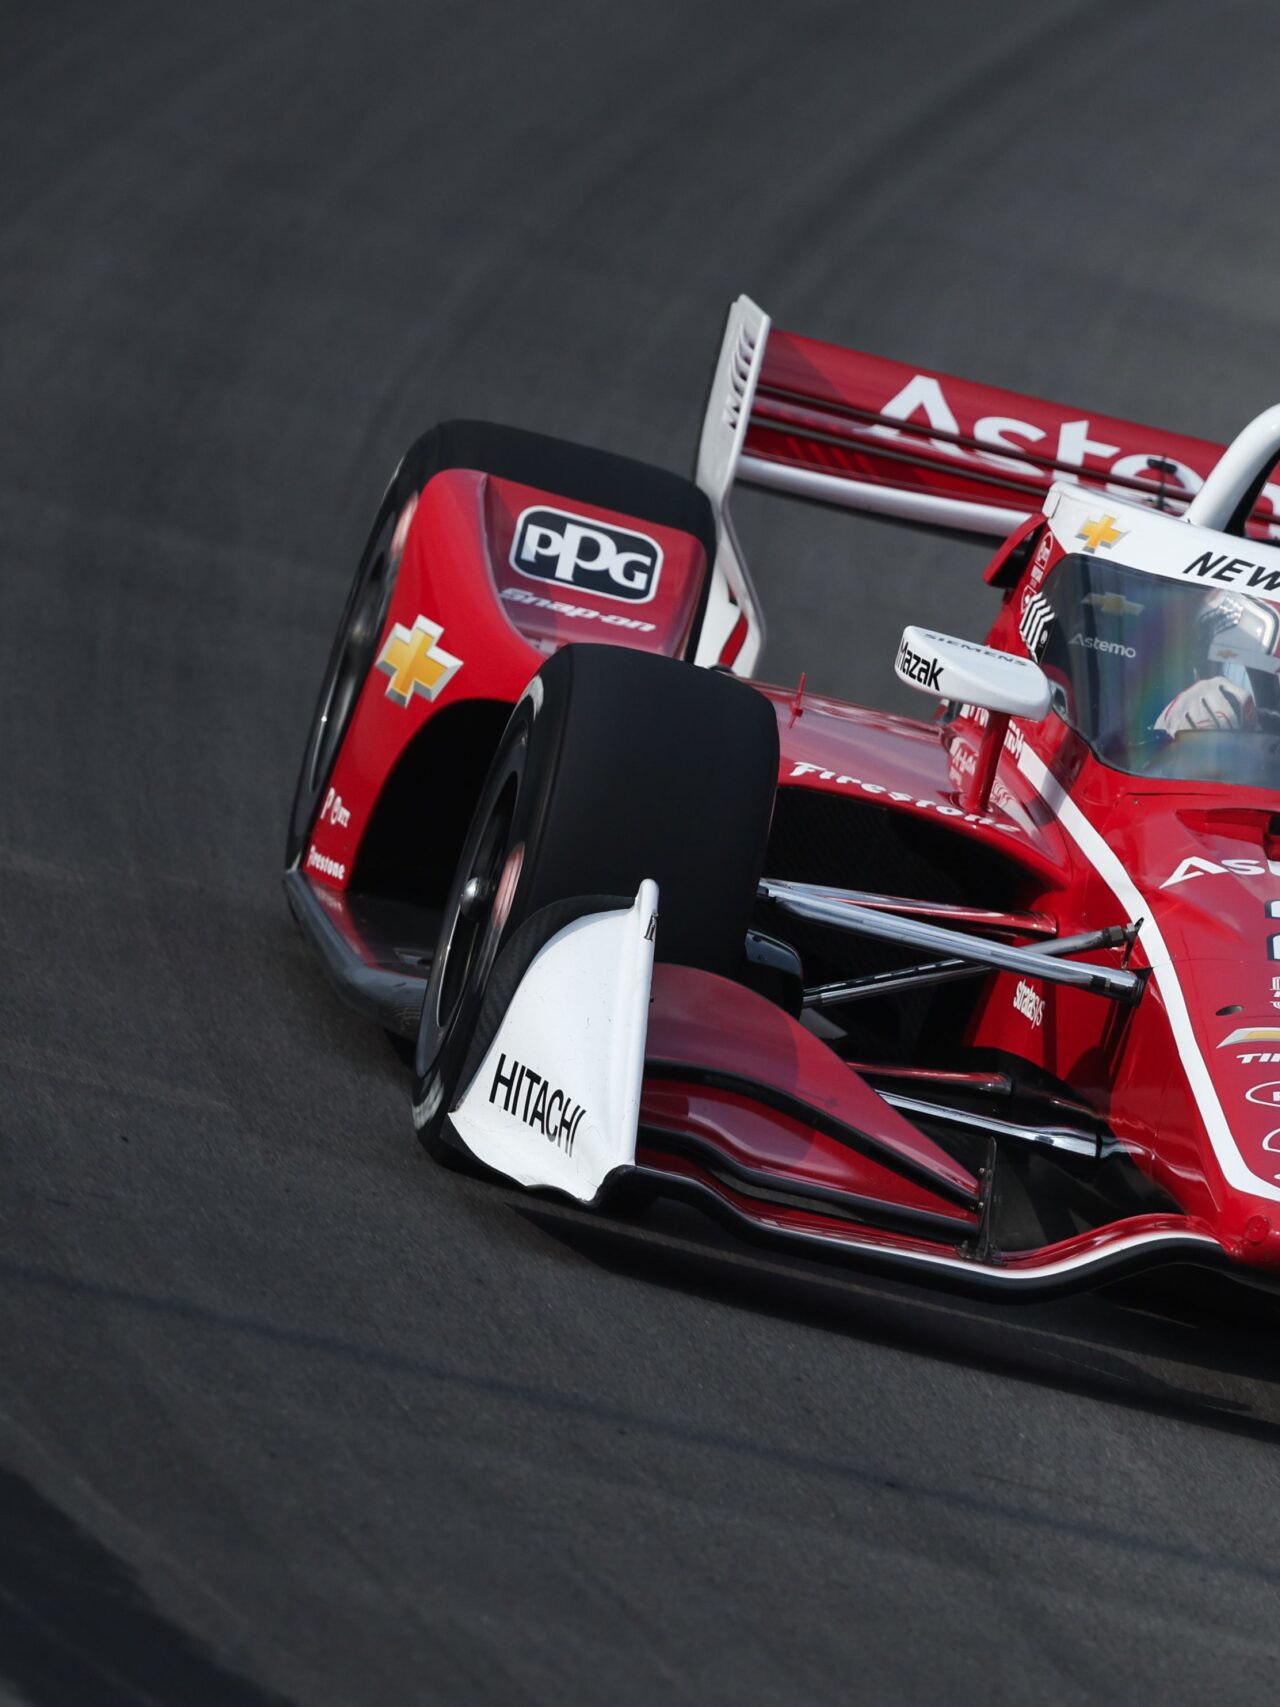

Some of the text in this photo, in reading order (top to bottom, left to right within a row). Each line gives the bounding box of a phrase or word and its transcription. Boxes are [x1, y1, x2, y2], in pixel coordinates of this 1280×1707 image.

[520, 522, 652, 591] PPG
[499, 587, 657, 632] Snap-on
[923, 633, 1028, 667] SIEMENS
[1068, 633, 1137, 659] Astemo
[789, 761, 1021, 833] Firestone
[488, 1053, 587, 1158] HITACHI
